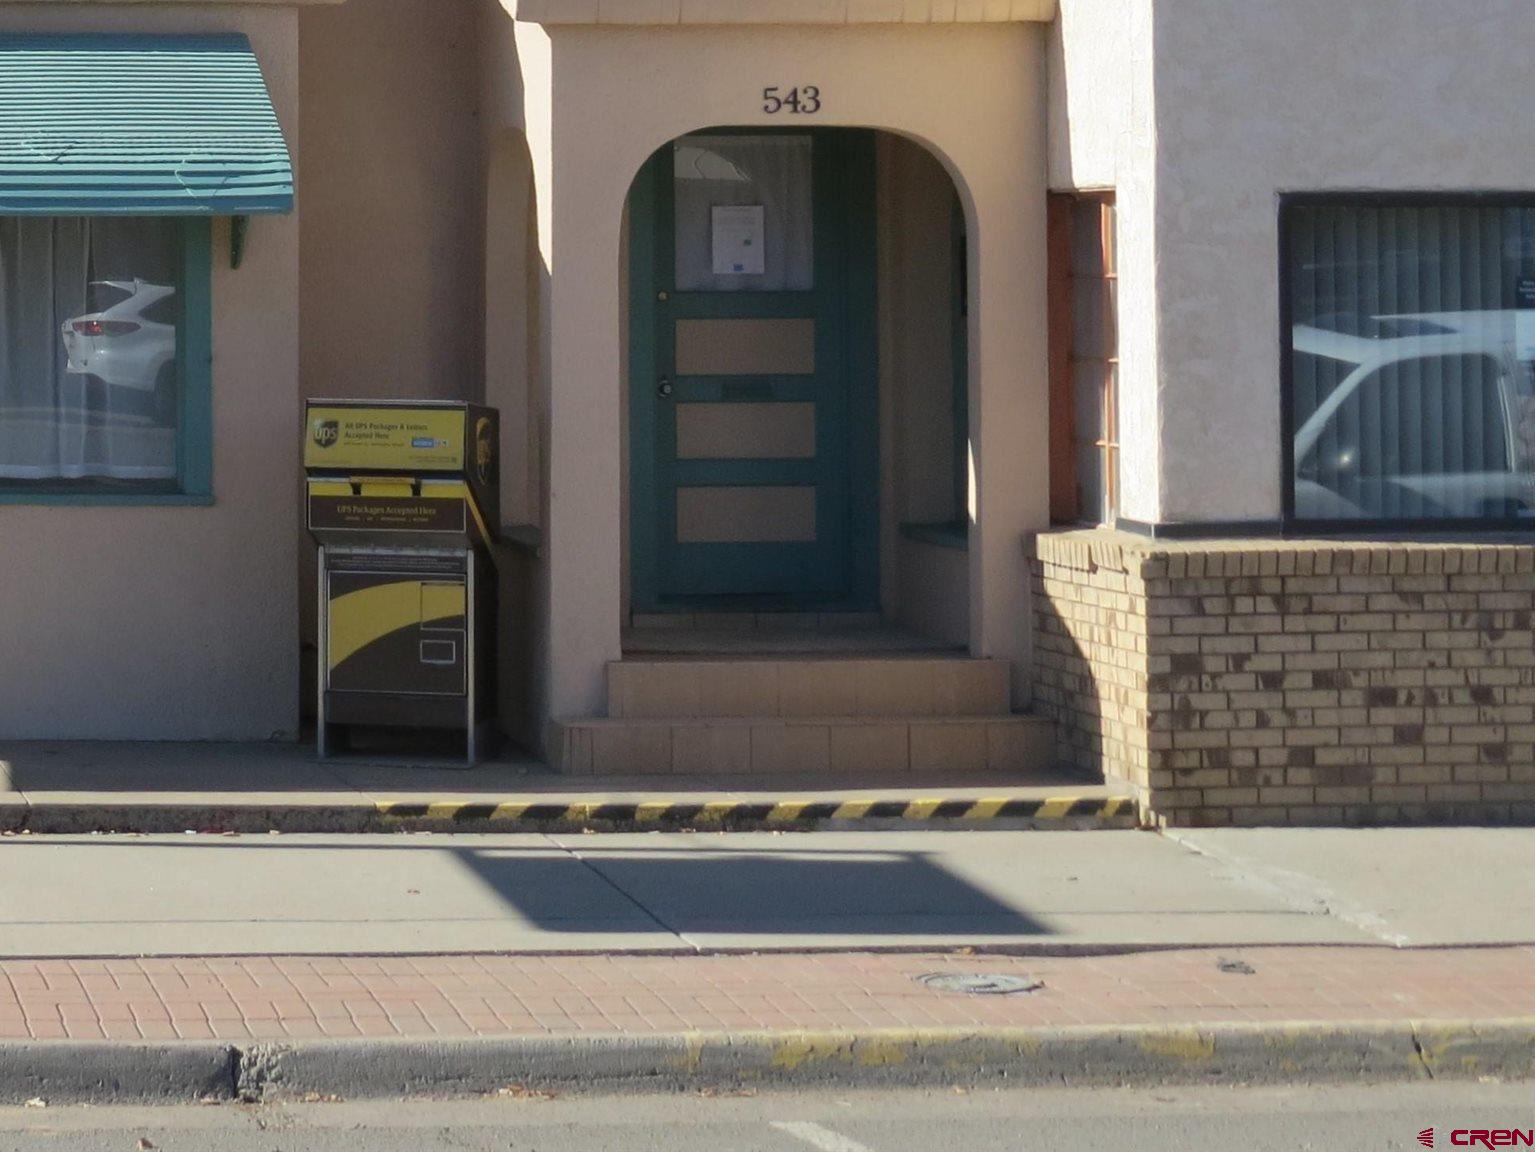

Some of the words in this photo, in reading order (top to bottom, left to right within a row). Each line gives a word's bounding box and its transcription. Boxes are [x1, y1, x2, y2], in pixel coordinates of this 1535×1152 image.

[763, 86, 821, 114] 543
[355, 422, 368, 430] UPS
[369, 423, 398, 432] Packages
[314, 427, 337, 445] ups
[344, 431, 373, 440] Accepted
[337, 505, 352, 514] UPS
[353, 505, 385, 516] Packages
[386, 506, 418, 517] Accepted
[419, 506, 436, 516] Here
